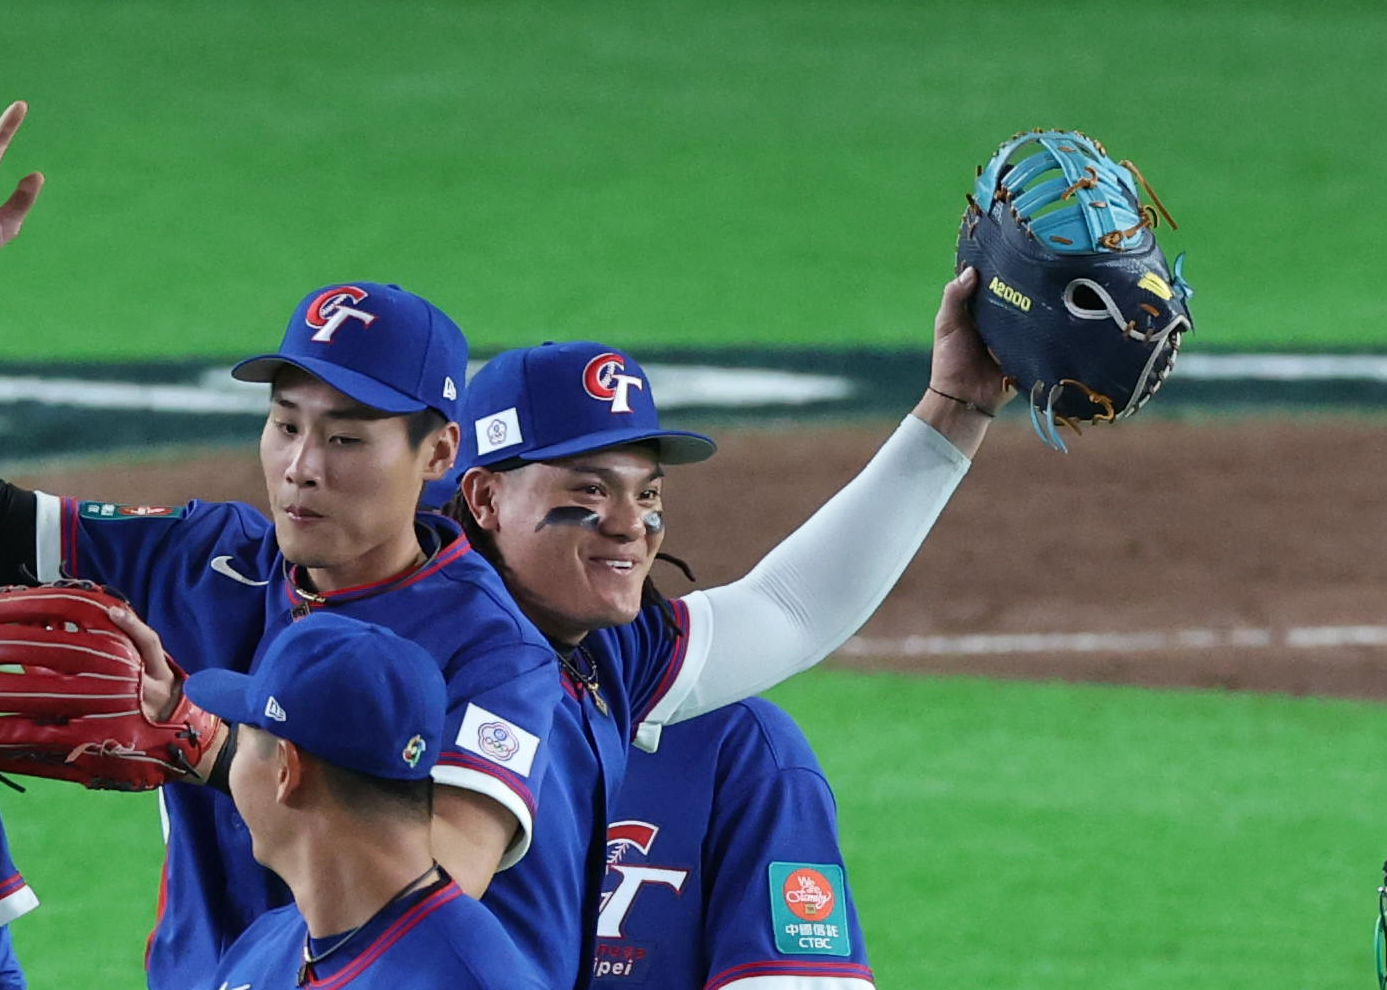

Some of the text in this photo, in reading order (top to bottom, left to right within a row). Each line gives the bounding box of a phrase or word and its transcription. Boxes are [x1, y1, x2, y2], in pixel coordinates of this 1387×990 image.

[989, 276, 1031, 312] A2000
[798, 937, 832, 949] CTBC
[593, 957, 634, 977] ipei
